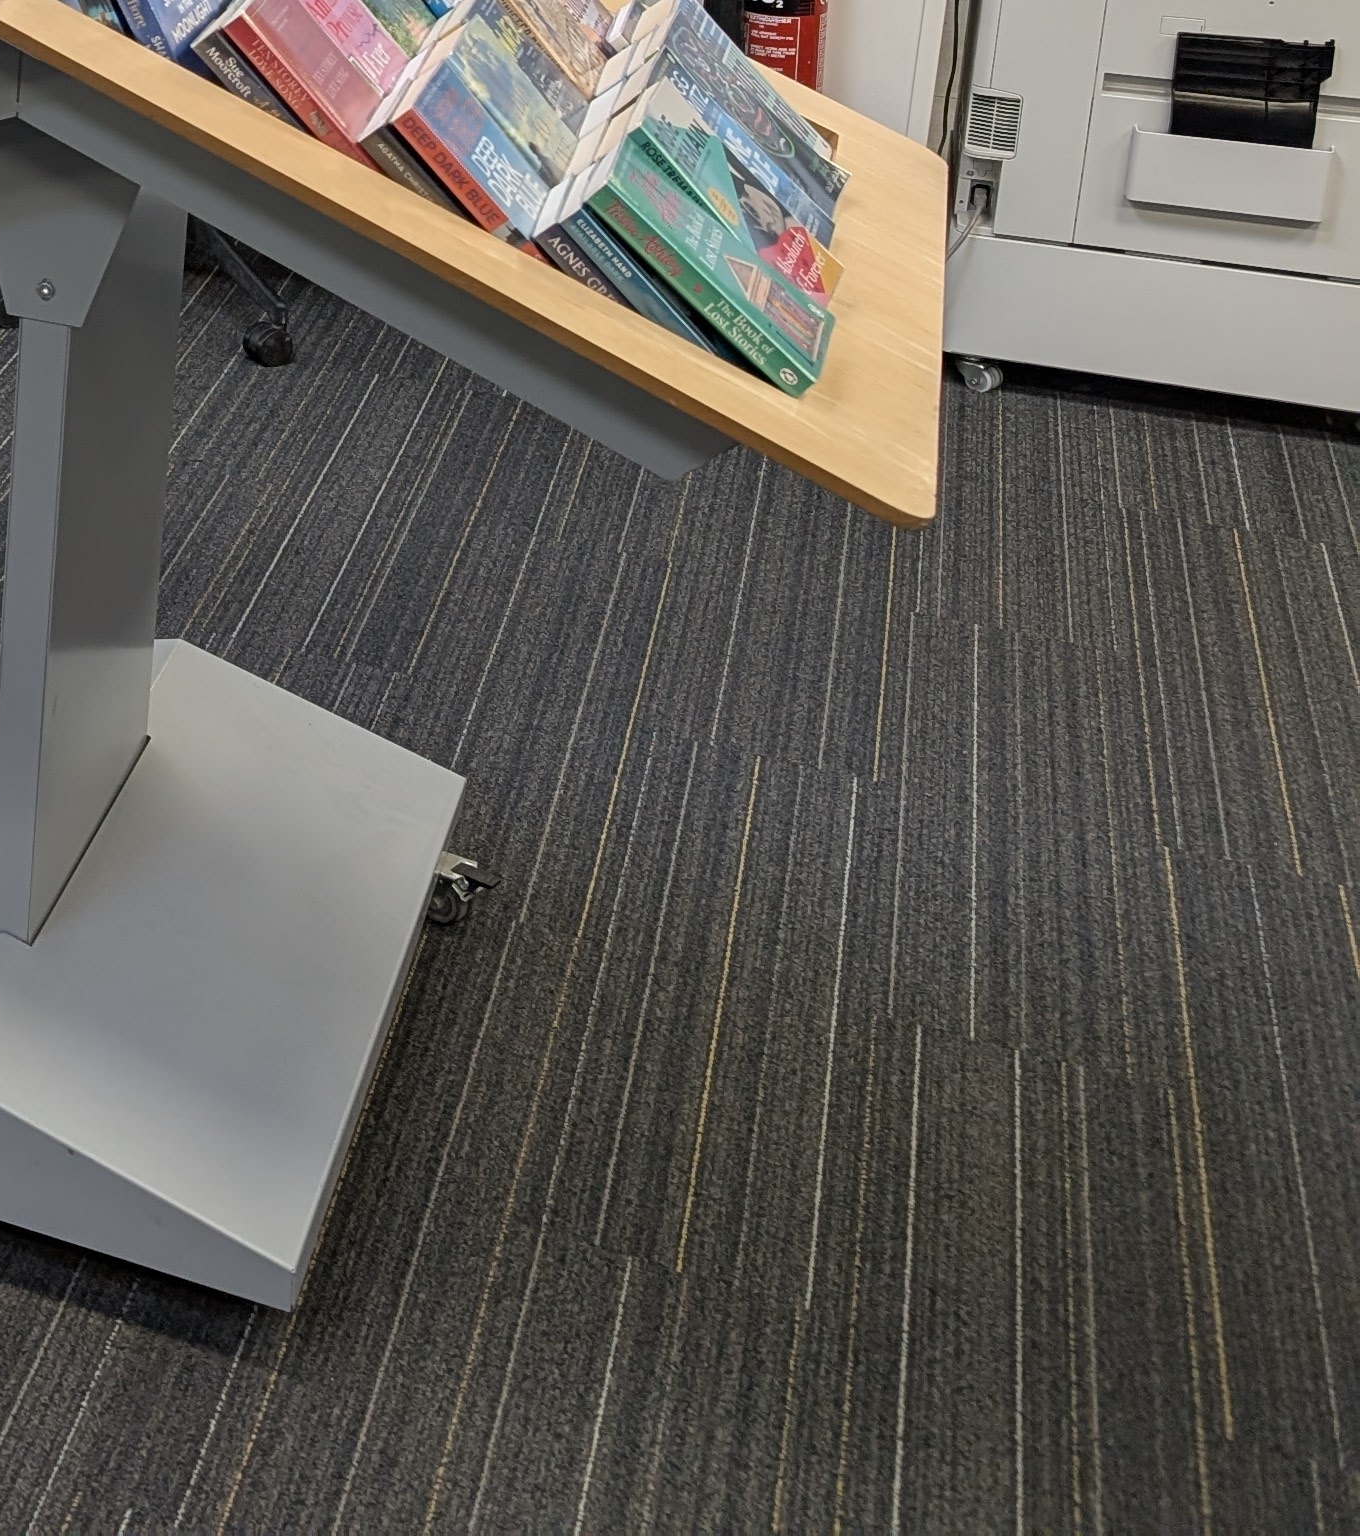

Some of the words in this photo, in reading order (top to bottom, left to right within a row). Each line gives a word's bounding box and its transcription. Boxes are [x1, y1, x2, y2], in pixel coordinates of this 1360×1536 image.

[327, 1, 363, 44] Prowse
[205, 46, 253, 99] Moorcroft
[227, 55, 245, 78] Sue
[248, 49, 273, 79] LOVE
[274, 76, 300, 110] SONG
[251, 38, 273, 61] TEN
[275, 61, 312, 102] STOREY
[402, 116, 437, 151] DEEP
[431, 151, 469, 189] DARK
[465, 188, 501, 224] BLUE
[470, 135, 497, 178] DEEP
[487, 152, 525, 208] DARK
[640, 140, 664, 167] ROSE
[663, 164, 704, 208] TREMAIN
[514, 172, 548, 222] BLUE
[575, 217, 614, 260] ELIZABETH
[611, 254, 633, 280] HAND
[775, 227, 810, 276] Absolutely
[703, 302, 729, 331] Lost
[728, 329, 768, 366] Stories
[716, 299, 736, 318] The
[733, 315, 765, 345] Book
[762, 342, 776, 356] of
